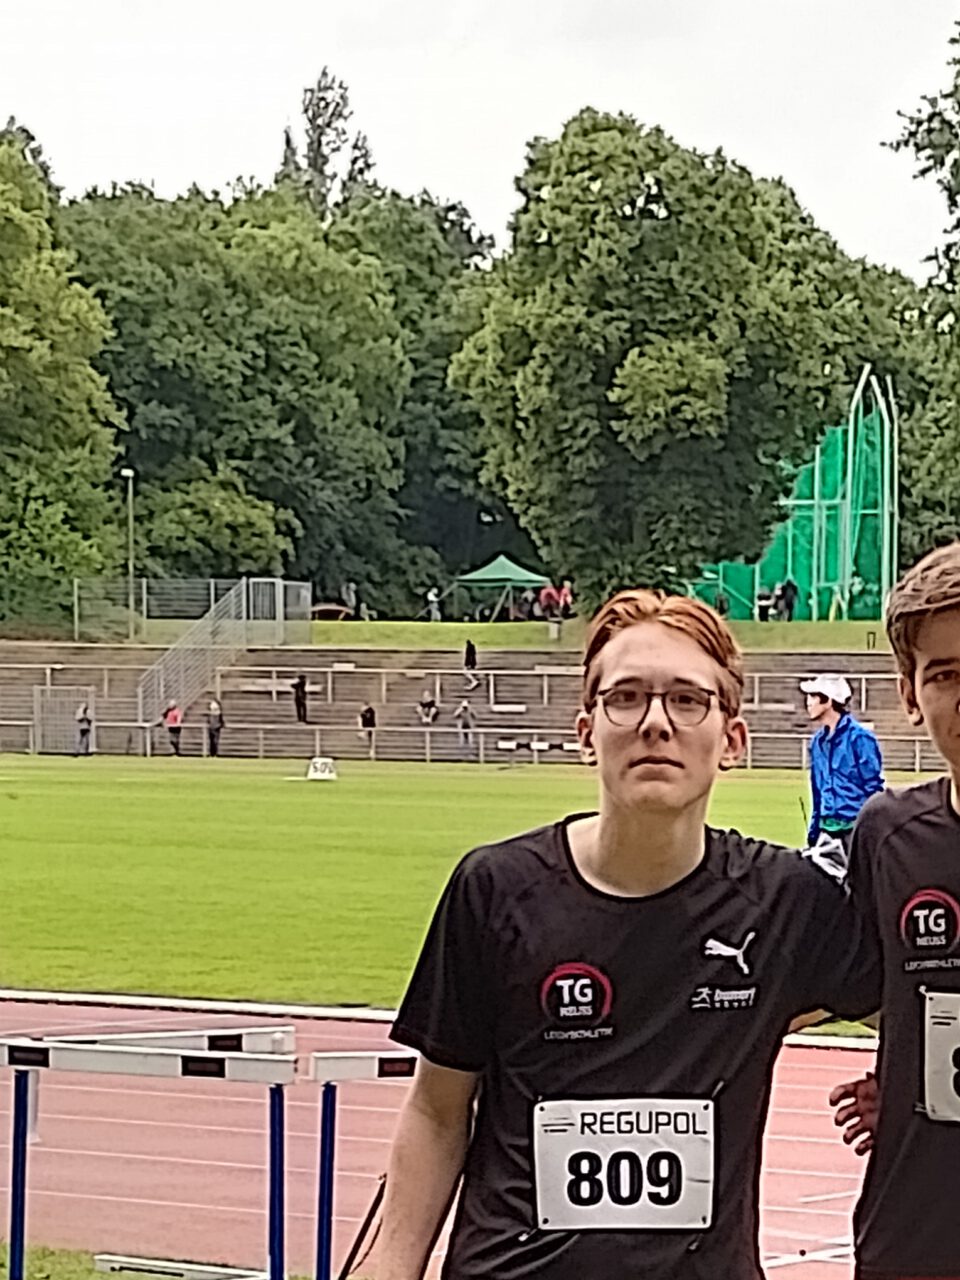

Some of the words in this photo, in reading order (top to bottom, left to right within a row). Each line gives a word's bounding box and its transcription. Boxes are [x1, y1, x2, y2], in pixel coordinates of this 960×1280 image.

[913, 908, 946, 934] TG
[555, 978, 593, 1004] TG
[580, 1111, 708, 1135] REGUPOL
[566, 1151, 683, 1206] 809
